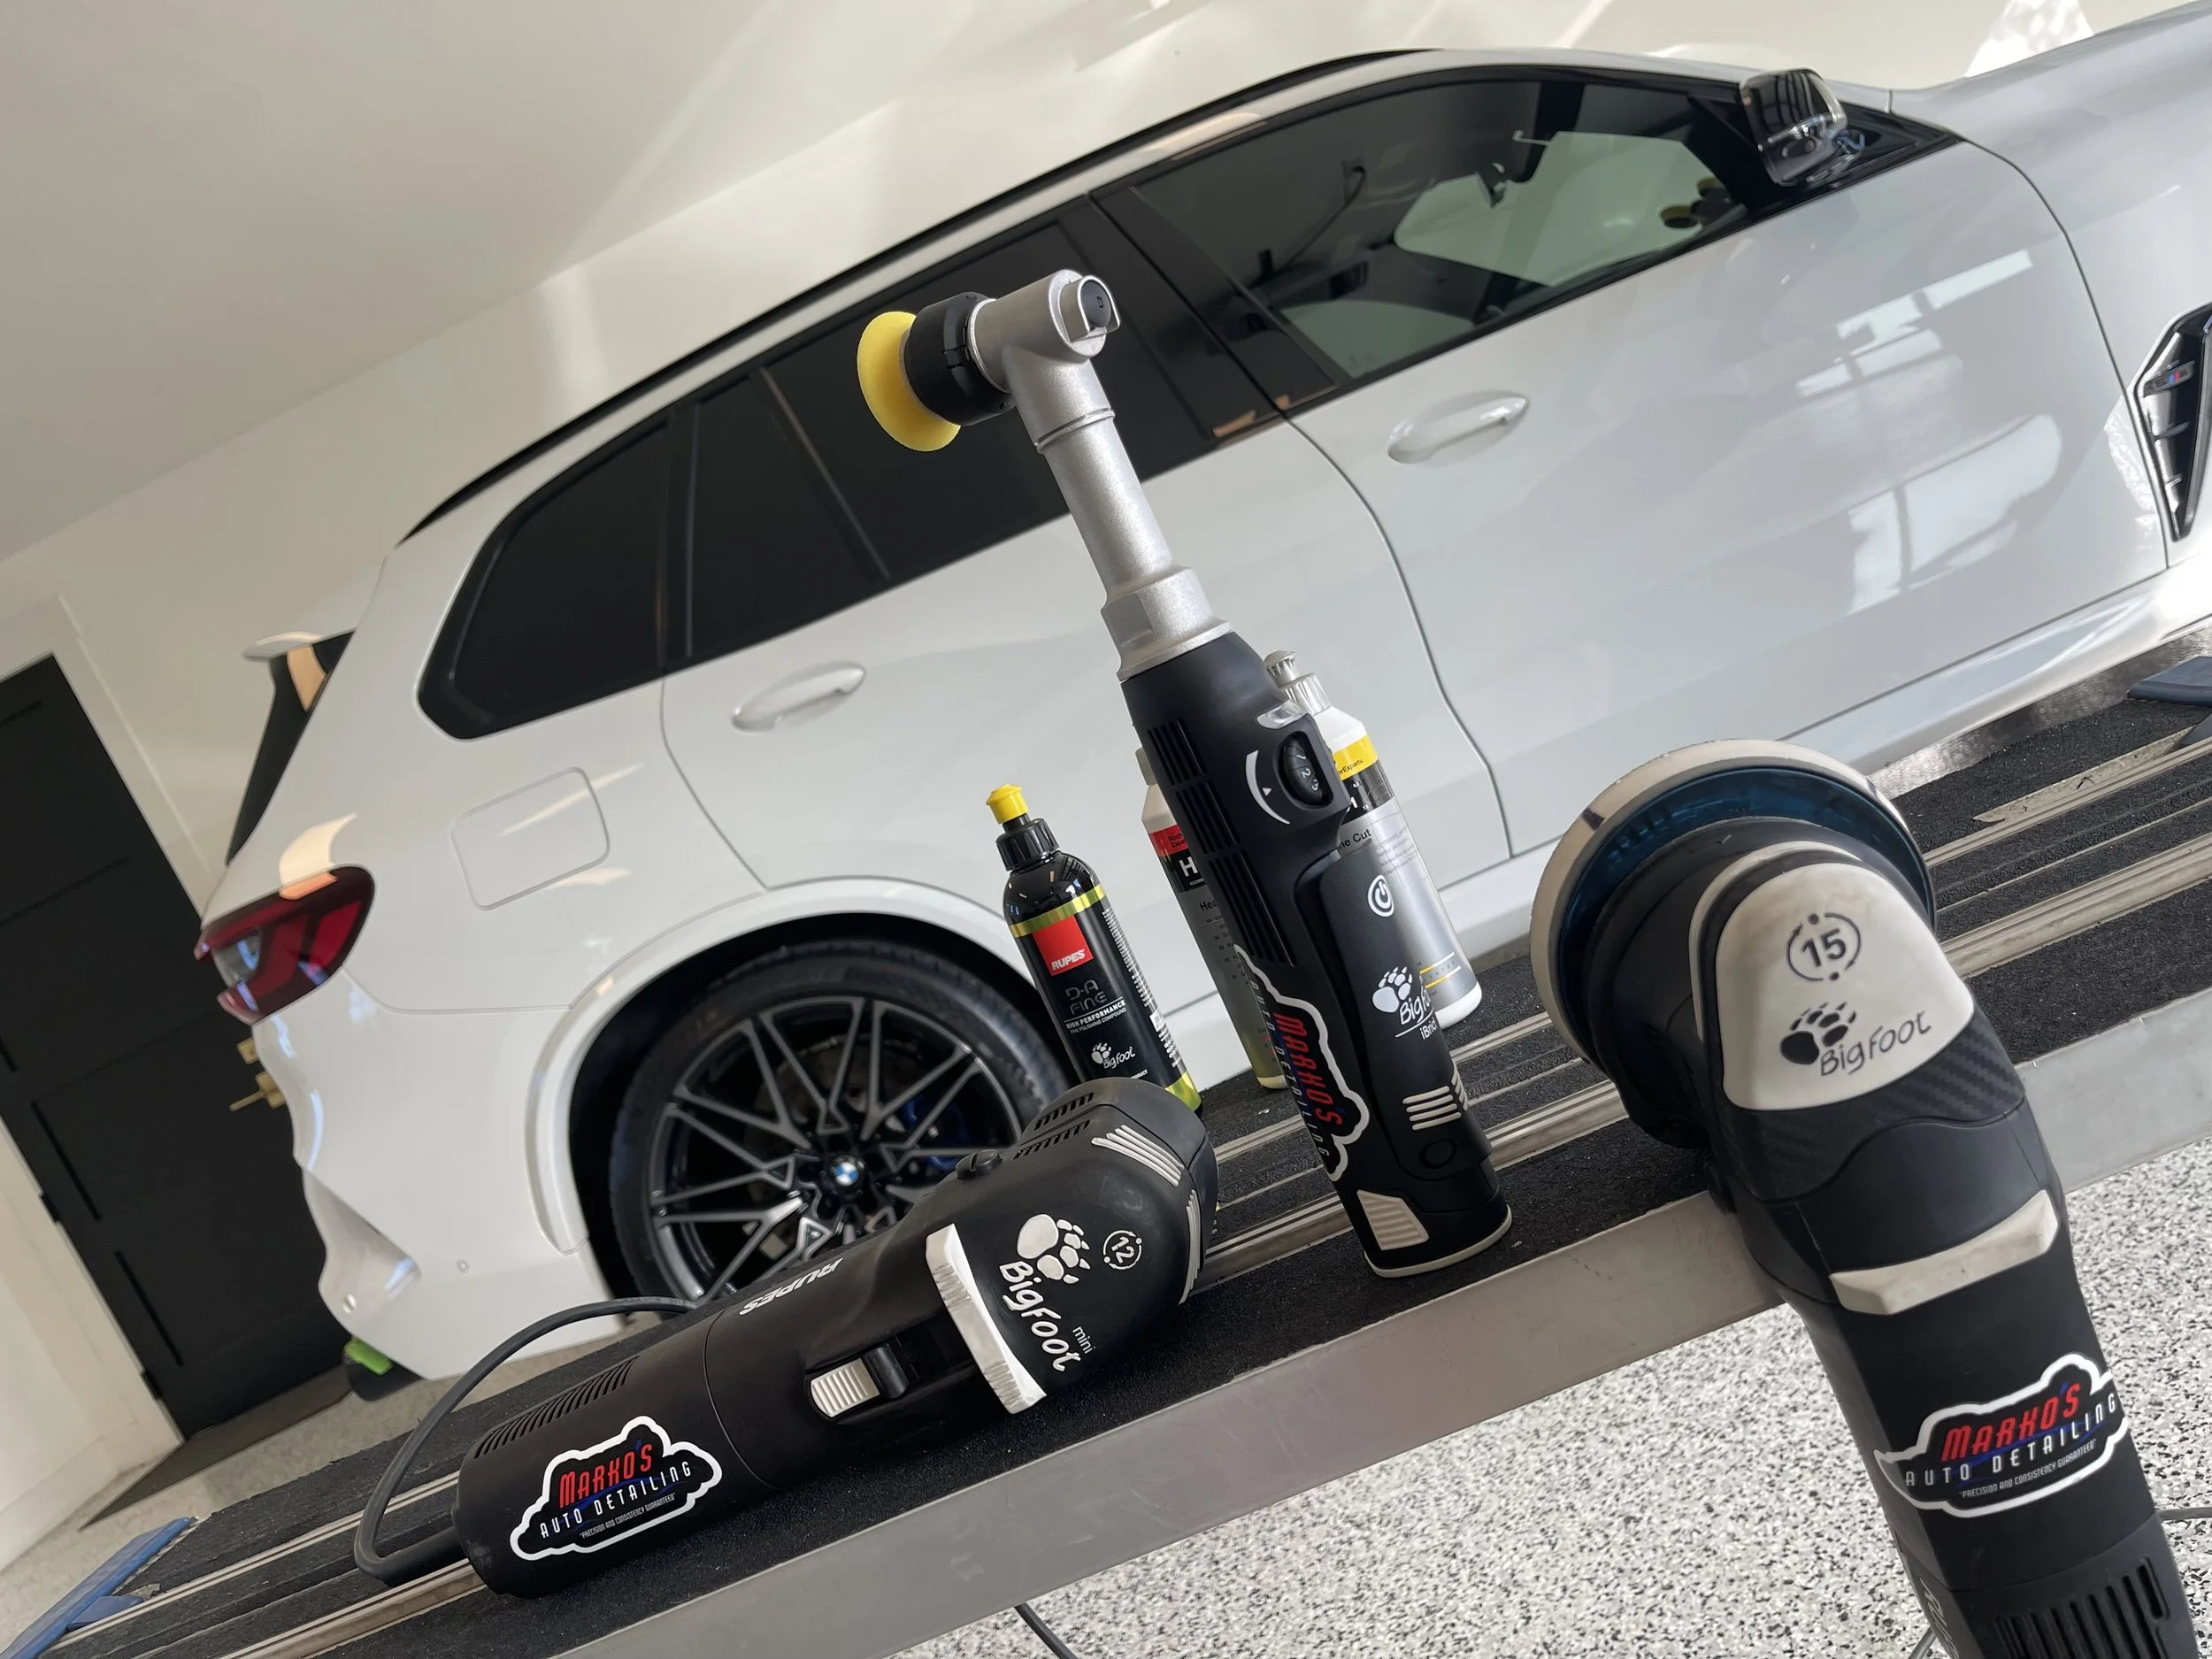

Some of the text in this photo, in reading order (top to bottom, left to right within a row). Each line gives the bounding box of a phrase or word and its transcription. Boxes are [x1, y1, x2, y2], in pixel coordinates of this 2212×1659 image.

[1301, 768, 1311, 779] 2
[1311, 779, 1320, 791] 3
[1339, 828, 1371, 849] ne Cut
[1051, 948, 1086, 971] RUPES
[1801, 928, 1847, 968] 15
[1065, 999, 1126, 1030] HIGH PERFORMANCE
[1070, 991, 1107, 1015] FINE
[1101, 1007, 1127, 1025] COMPOUND
[1250, 979, 1330, 1156] AUTO DETAILING
[1110, 1236, 1135, 1263] 12
[739, 1257, 844, 1316] RUPES
[1072, 1326, 1096, 1355] mini
[1904, 1392, 2116, 1487] AUTO DETAILING
[1999, 1480, 2013, 1490] AND
[2014, 1462, 2056, 1485] CONSISTENCY
[541, 1461, 691, 1539] AUTO DETAILING
[605, 1519, 616, 1529] AND
[615, 1506, 645, 1525] CONSISTENCY
